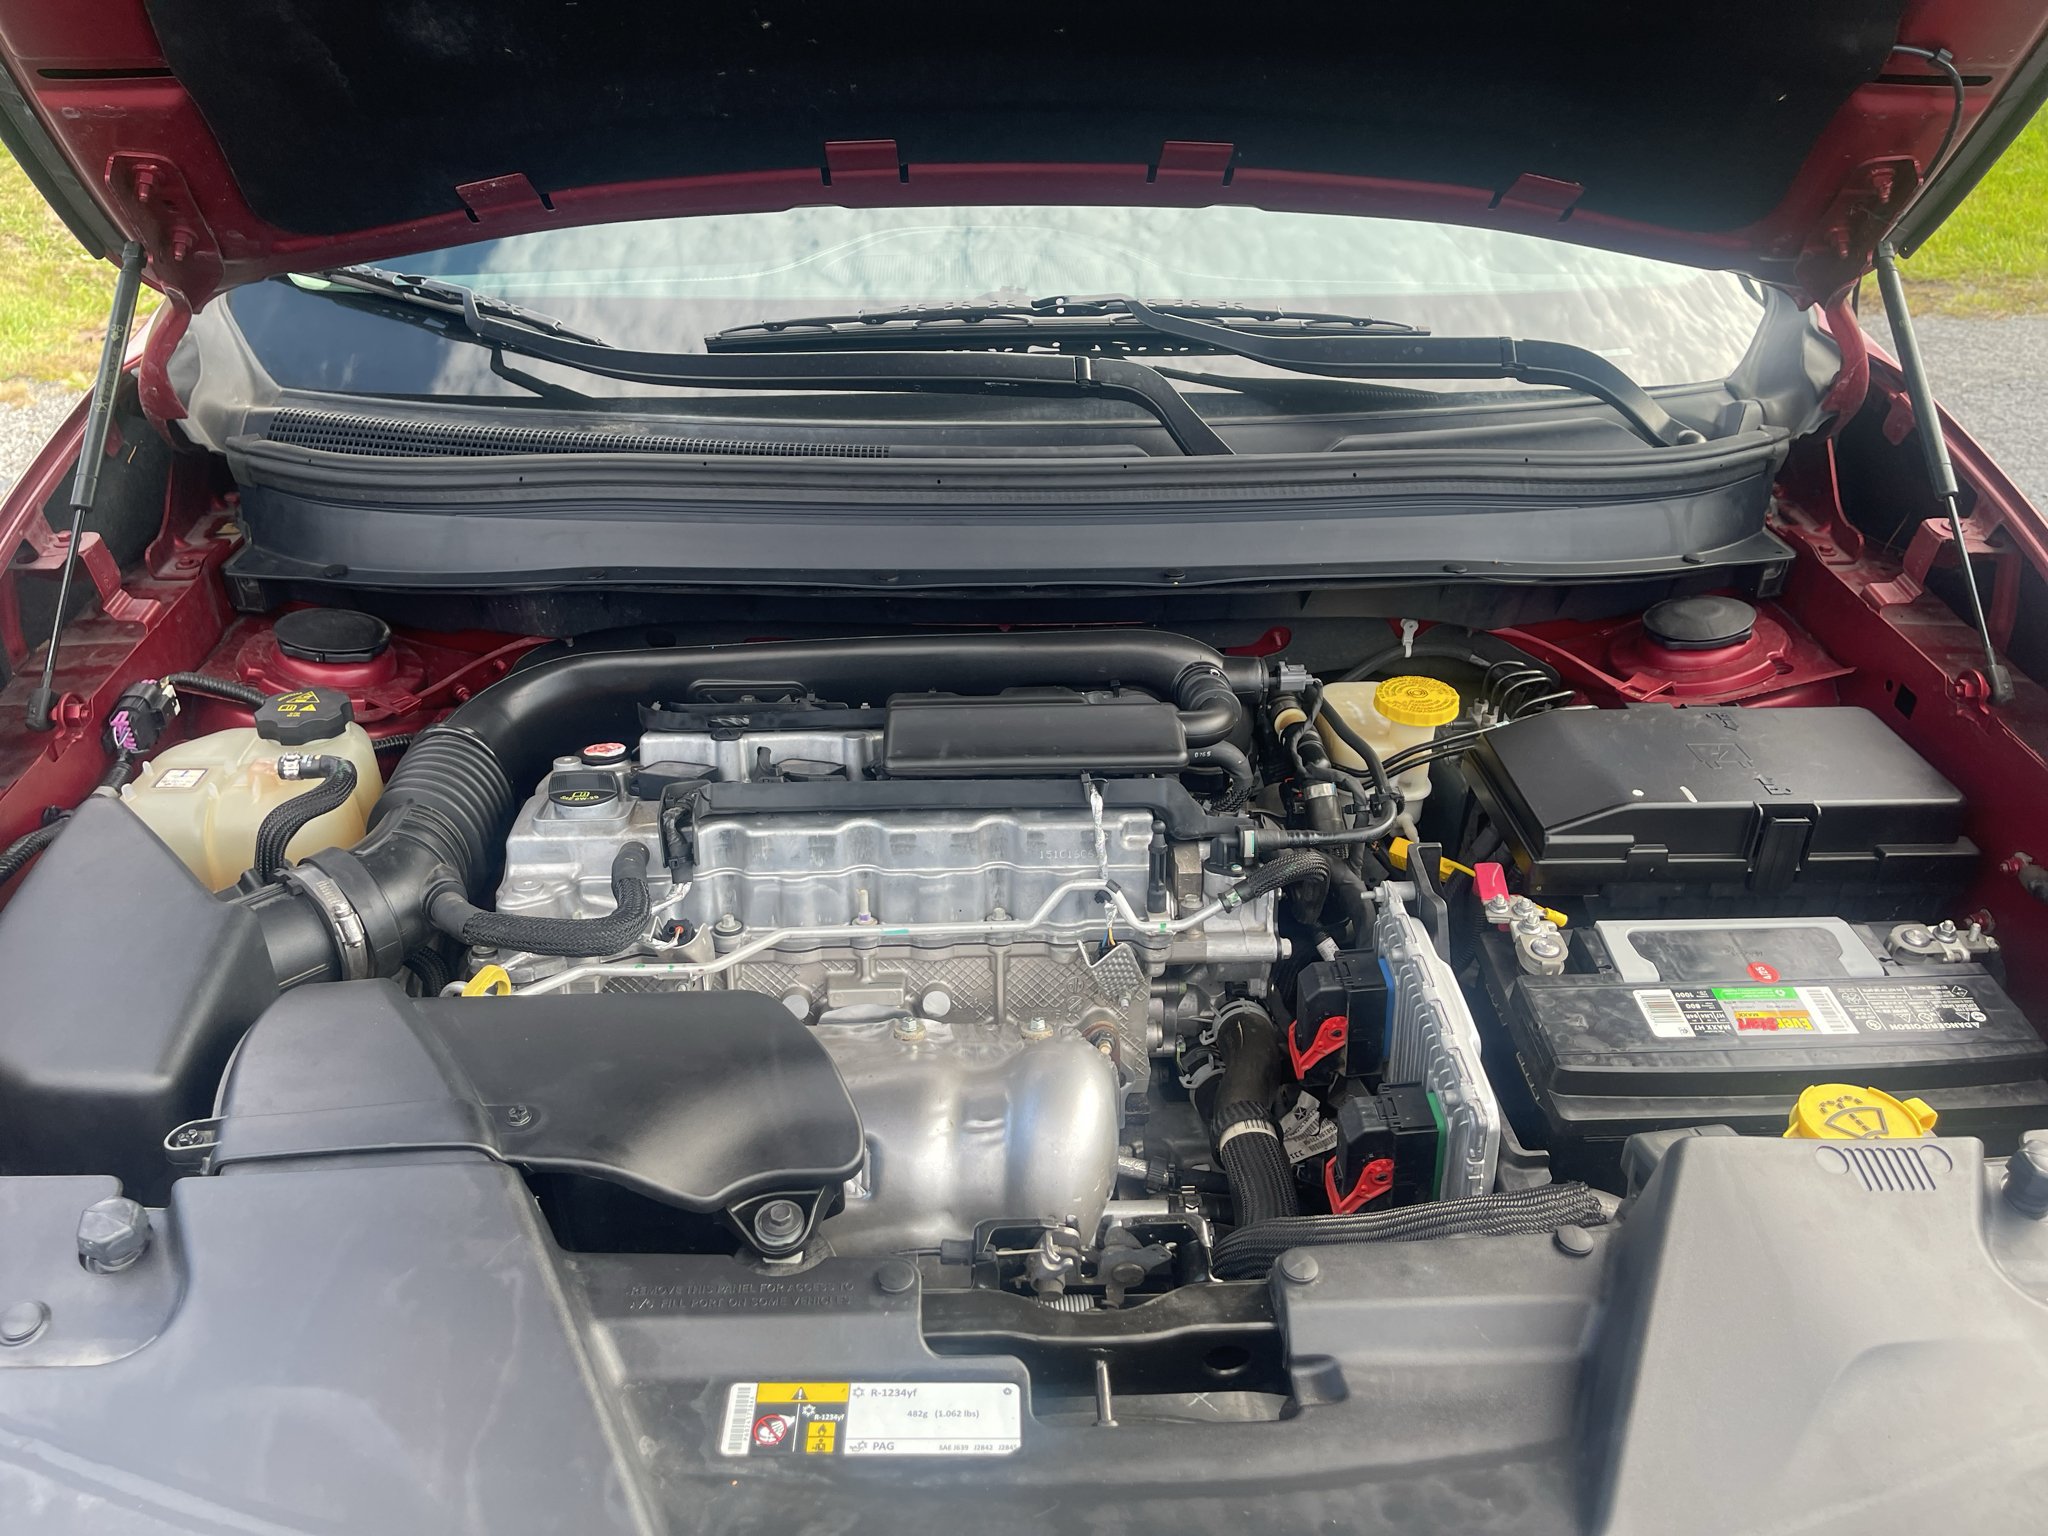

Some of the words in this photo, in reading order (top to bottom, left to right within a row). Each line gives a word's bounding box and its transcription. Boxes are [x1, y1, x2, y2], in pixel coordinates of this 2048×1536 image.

[1693, 1023, 1705, 1031] H7
[1705, 1023, 1731, 1031] MAXX
[1736, 1016, 1814, 1031] EverStart
[631, 1284, 682, 1296] REMOVE
[687, 1283, 714, 1295] THIS
[717, 1283, 754, 1295] PANEL
[759, 1282, 785, 1293] FOR
[786, 1282, 835, 1293] ACCESS
[838, 1281, 854, 1292] TO
[660, 1298, 687, 1309] FILL
[691, 1297, 723, 1308] PORT
[728, 1297, 748, 1307] ON
[751, 1296, 787, 1307] SOME
[793, 1295, 851, 1307] VEHICLES
[870, 1388, 918, 1398] R-1234yf
[813, 1413, 846, 1422] R-1234yf
[907, 1411, 929, 1419] 482g
[934, 1410, 962, 1419] (1.062
[963, 1410, 980, 1419] lbs)
[872, 1442, 895, 1451] PAG
